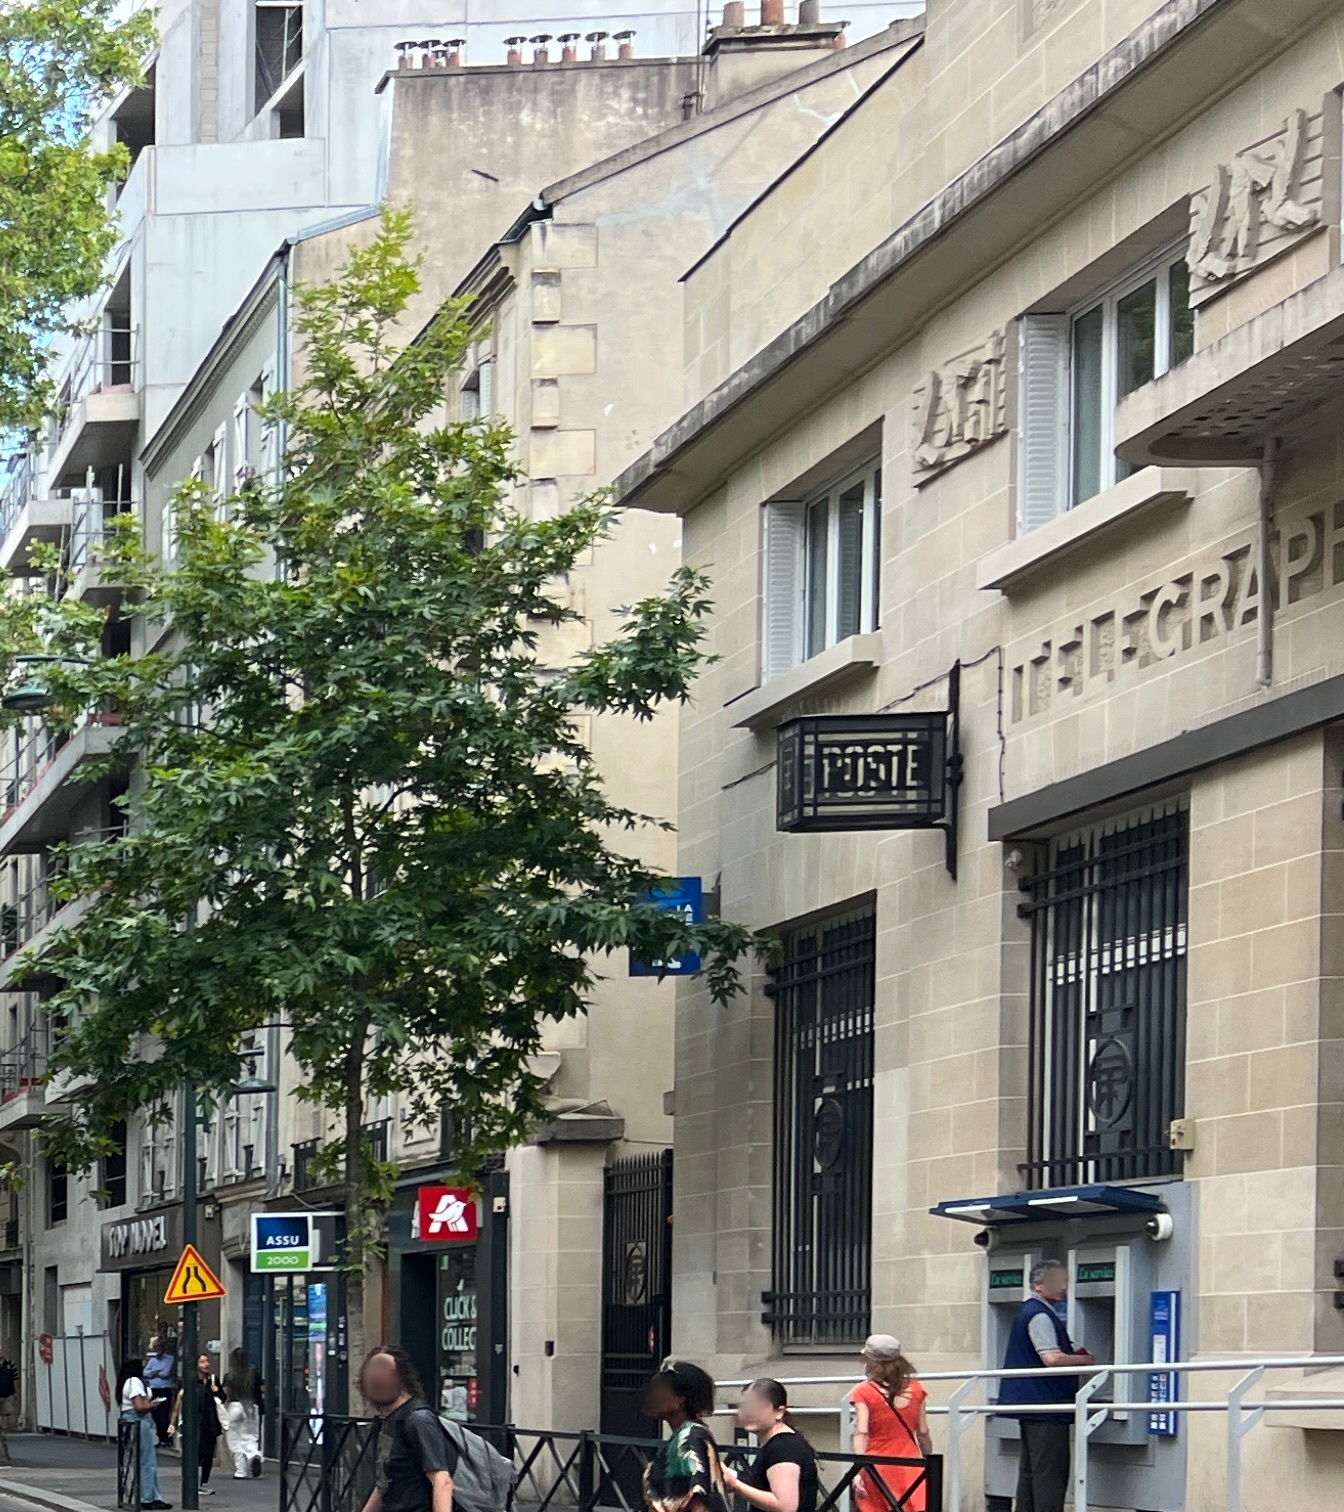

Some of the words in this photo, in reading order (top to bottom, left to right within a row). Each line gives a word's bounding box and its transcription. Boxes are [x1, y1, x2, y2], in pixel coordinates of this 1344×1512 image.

[822, 744, 919, 789] POSTE
[265, 1235, 300, 1246] ASSU
[266, 1255, 299, 1265] 2000
[444, 1296, 470, 1320] CLICK
